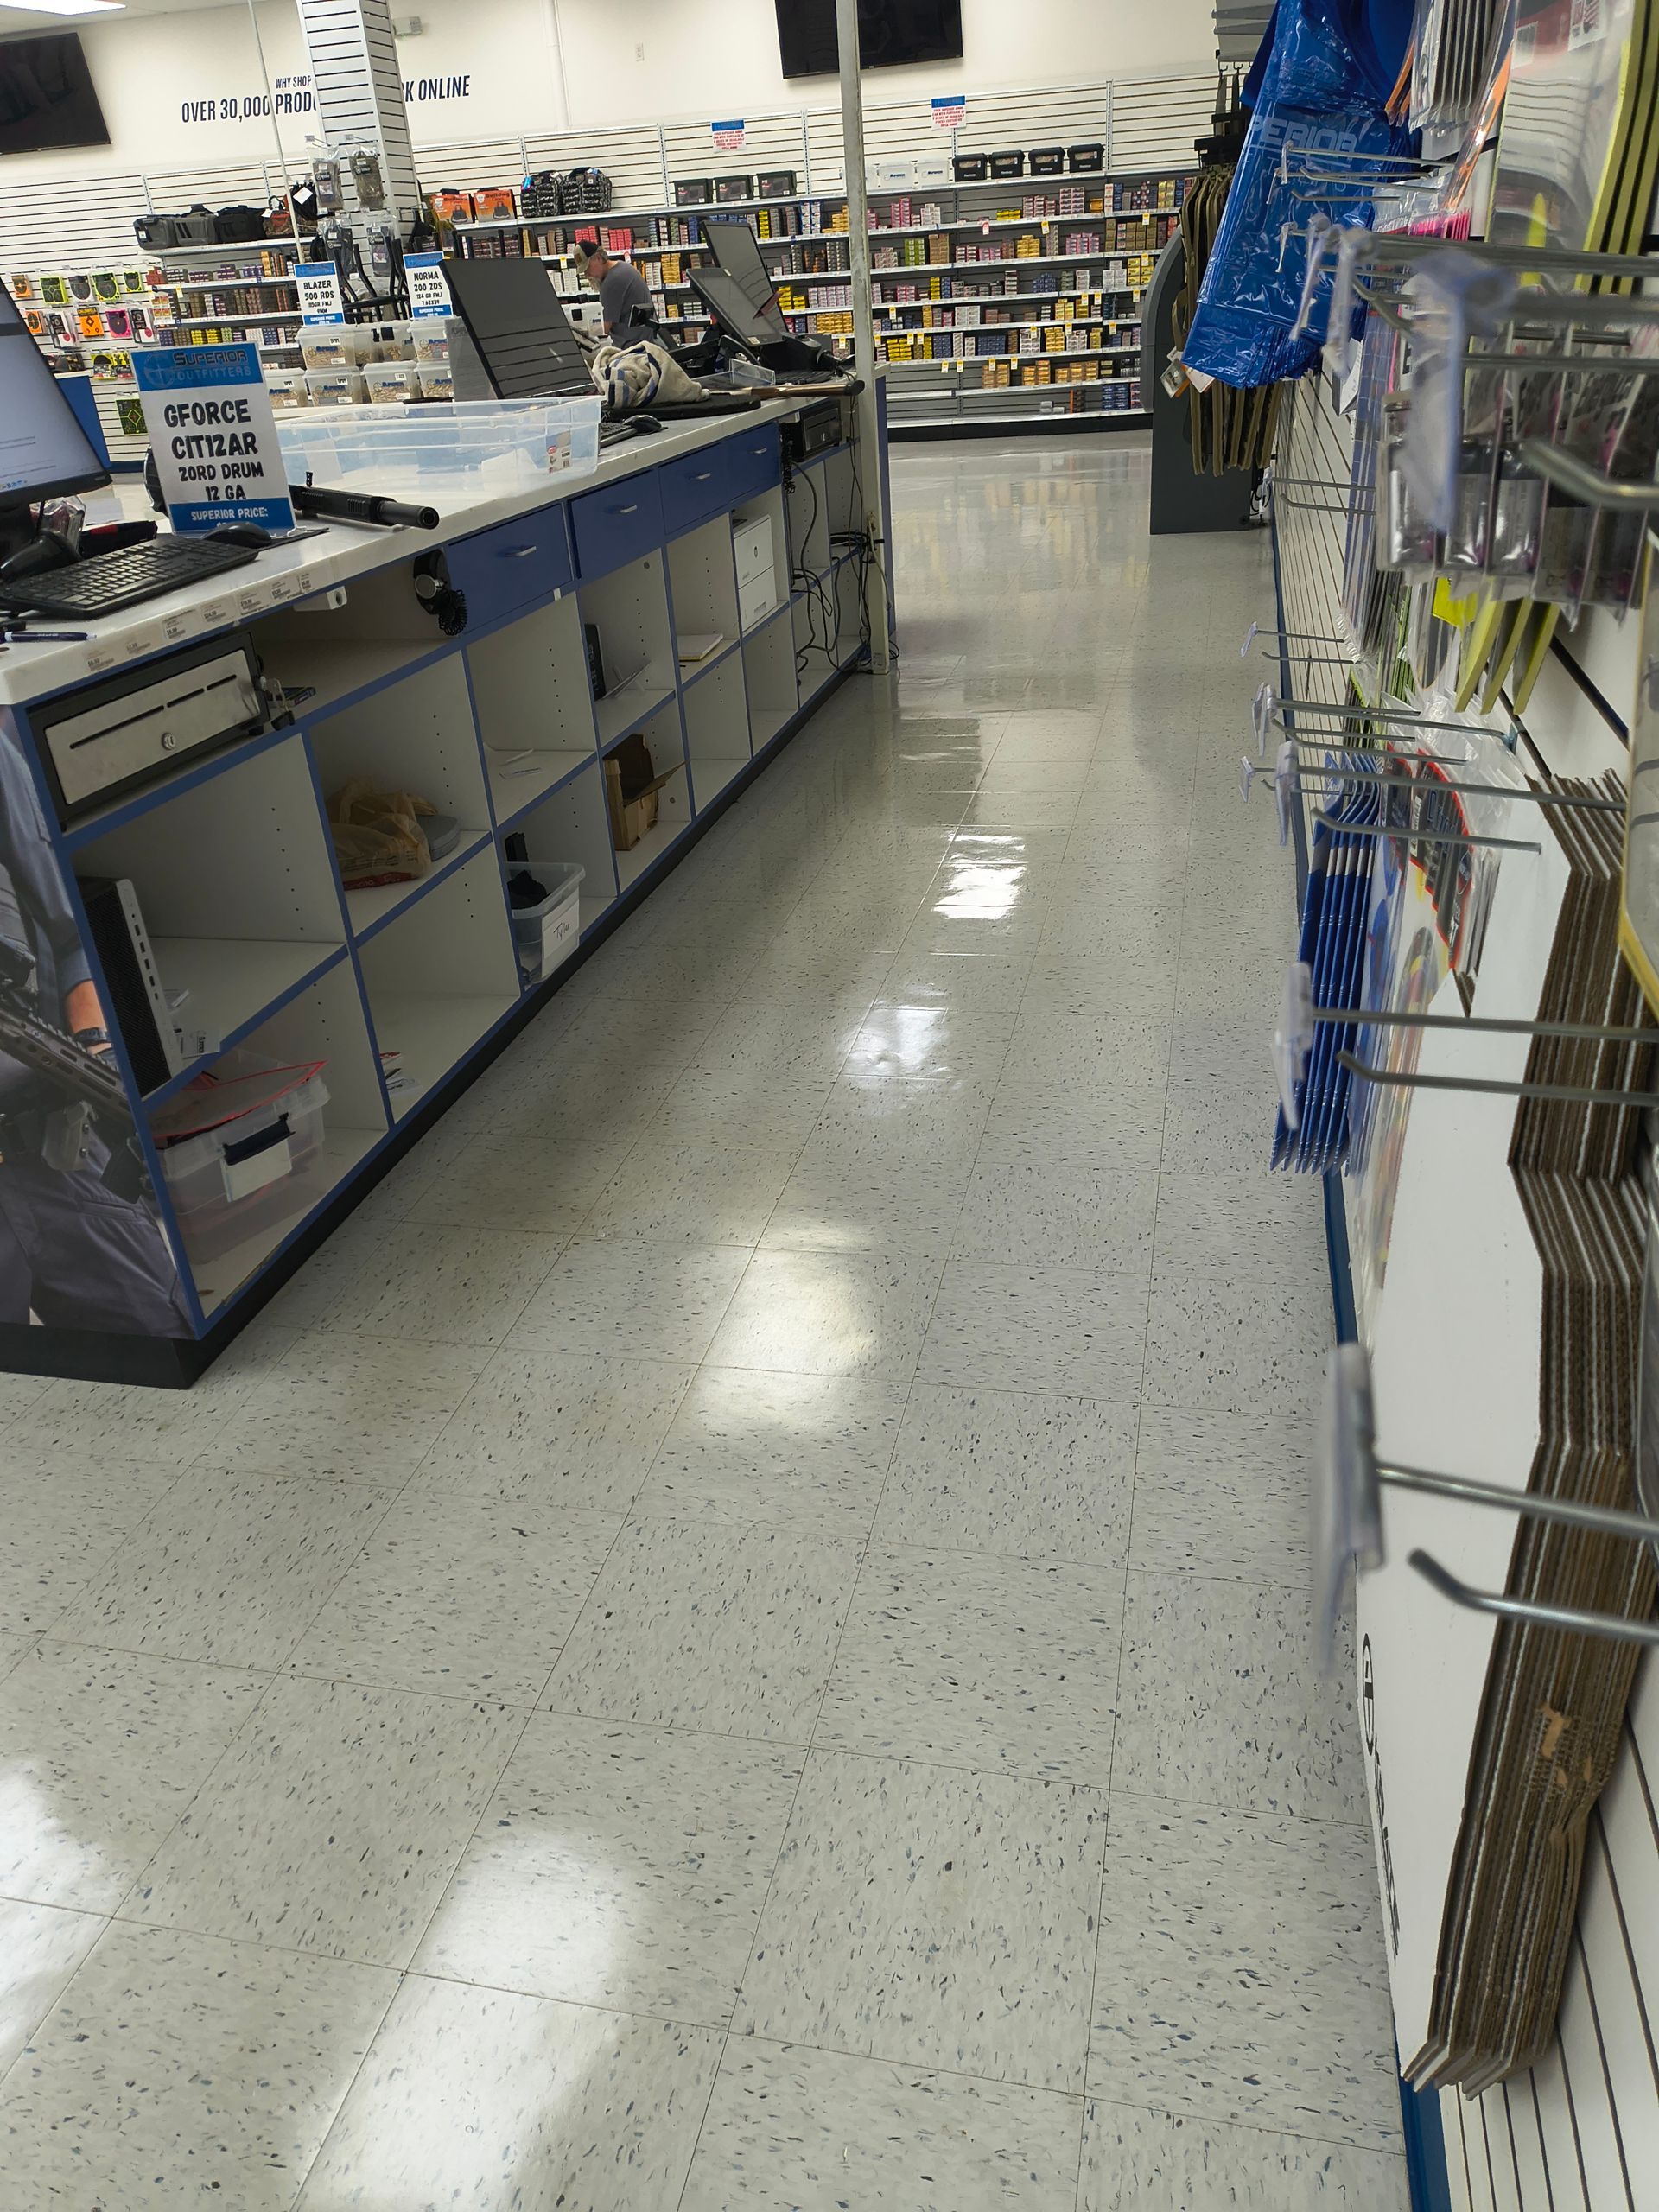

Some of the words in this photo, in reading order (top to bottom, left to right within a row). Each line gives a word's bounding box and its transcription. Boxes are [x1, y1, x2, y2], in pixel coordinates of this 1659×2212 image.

[276, 78, 291, 89] WHY
[181, 100, 216, 123] OVER
[220, 95, 270, 123] 30,000
[418, 75, 471, 101] ONLINE
[413, 271, 439, 281] NORMA
[303, 280, 332, 289] BLAZER
[414, 283, 427, 292] 200
[304, 292, 318, 301] 500
[174, 350, 247, 367] SUPERIOR
[177, 365, 252, 382] OUTFITTERS
[164, 398, 251, 428] GFORCE
[178, 464, 216, 482] 20RD
[221, 461, 264, 479] DRUM
[206, 486, 219, 501] 12
[225, 484, 246, 500] GA
[191, 509, 235, 521] SUPERIOR
[238, 506, 268, 518] PRICE:
